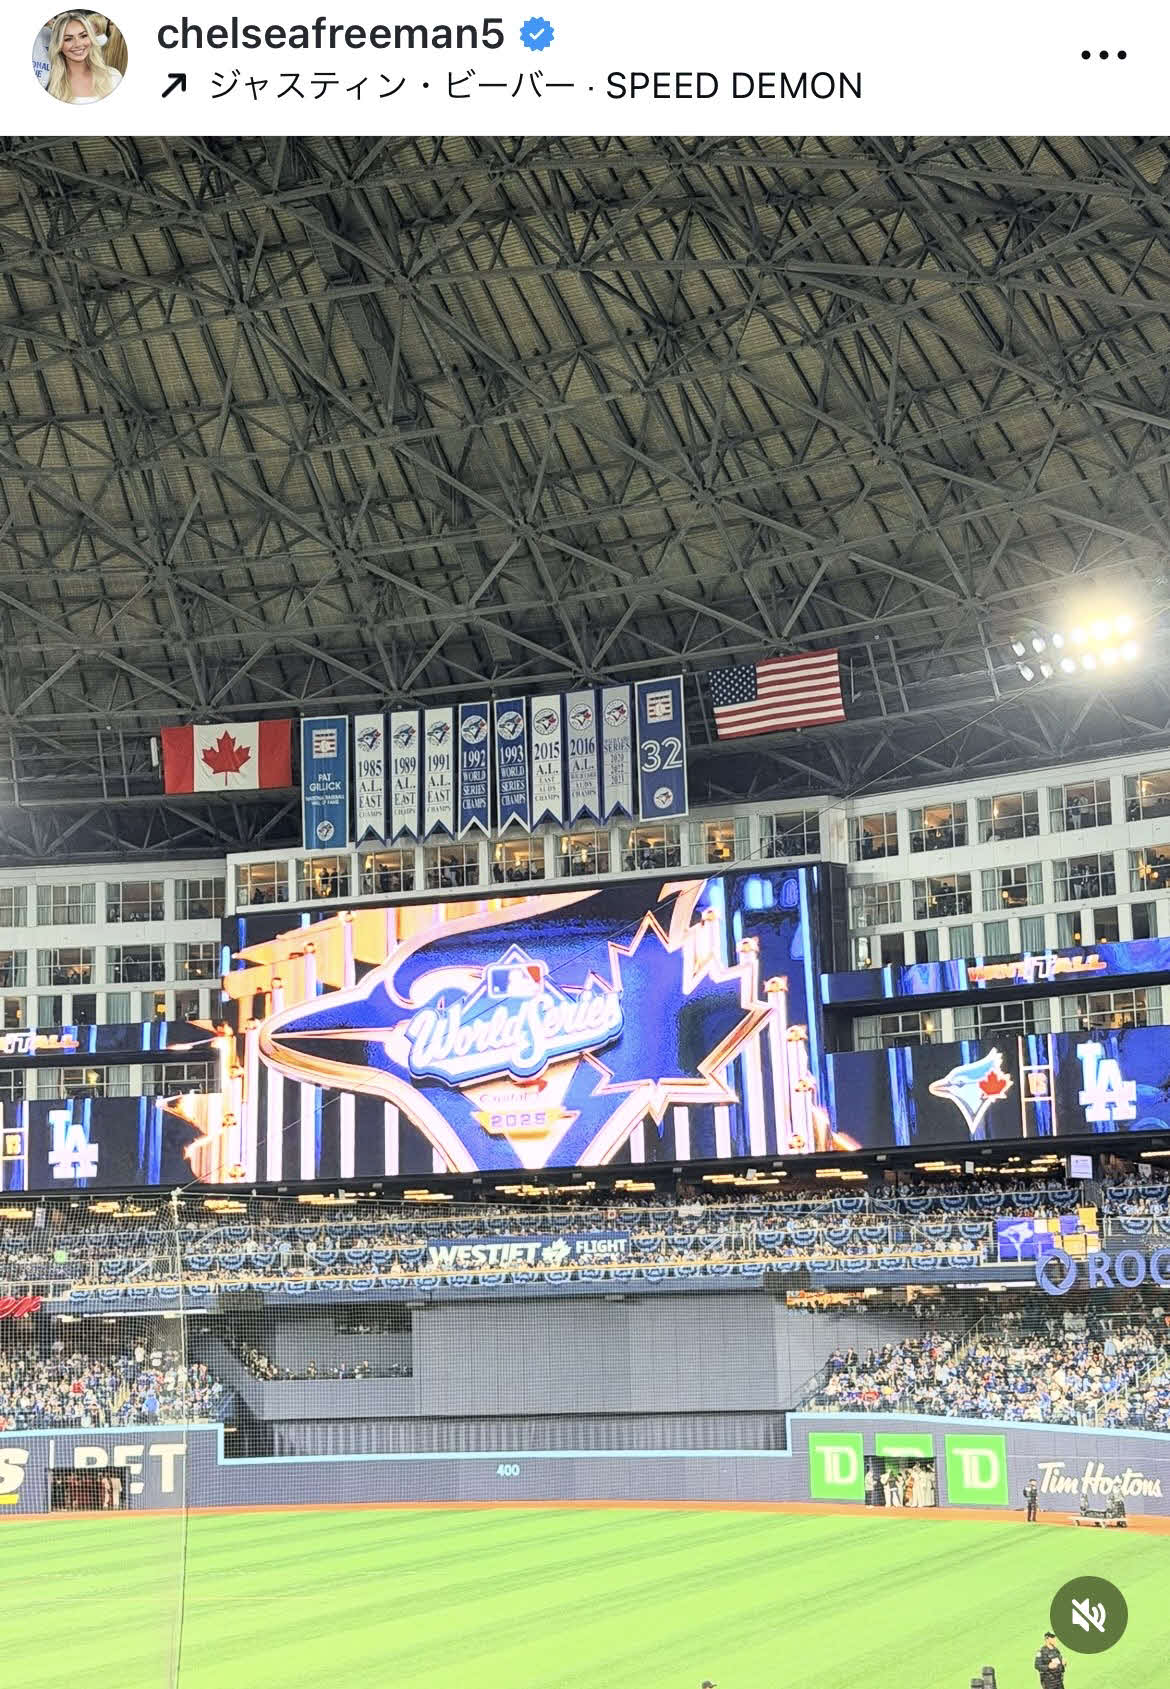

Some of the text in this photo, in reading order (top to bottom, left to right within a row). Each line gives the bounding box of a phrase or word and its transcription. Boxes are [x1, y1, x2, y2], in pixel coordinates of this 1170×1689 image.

[534, 742, 560, 760] 2015
[570, 737, 595, 756] 2016
[463, 750, 486, 768] 1992
[500, 744, 524, 764] 1993
[641, 737, 684, 773] 32
[359, 759, 382, 777] 1985
[394, 757, 416, 775] 1989
[428, 754, 450, 771] 1991
[536, 763, 558, 775] A.L.
[572, 758, 594, 771] A.L.
[318, 773, 332, 782] PAT
[462, 770, 486, 781] WORLD
[500, 766, 525, 777] WORLD
[309, 781, 342, 792] GILLICK
[359, 780, 382, 792] A.L.
[395, 777, 416, 790] A.L.
[428, 774, 451, 787] A.L.
[501, 780, 525, 792] SERIES
[427, 790, 451, 803] EAST
[463, 784, 486, 795] SERIES
[359, 795, 382, 808] EAST
[394, 792, 416, 806] EAST
[462, 797, 487, 809] CHAMPS
[501, 793, 526, 806] CHAMPS
[404, 983, 622, 1070] World Series
[1077, 1042, 1136, 1121] LA
[491, 1112, 546, 1129] 2025
[48, 1109, 99, 1178] LA
[428, 1239, 628, 1267] WESTJET FLIGHT
[496, 1463, 520, 1477] 400
[816, 1445, 858, 1486] TD
[952, 1447, 1000, 1490] TD
[1037, 1461, 1079, 1496] Tim
